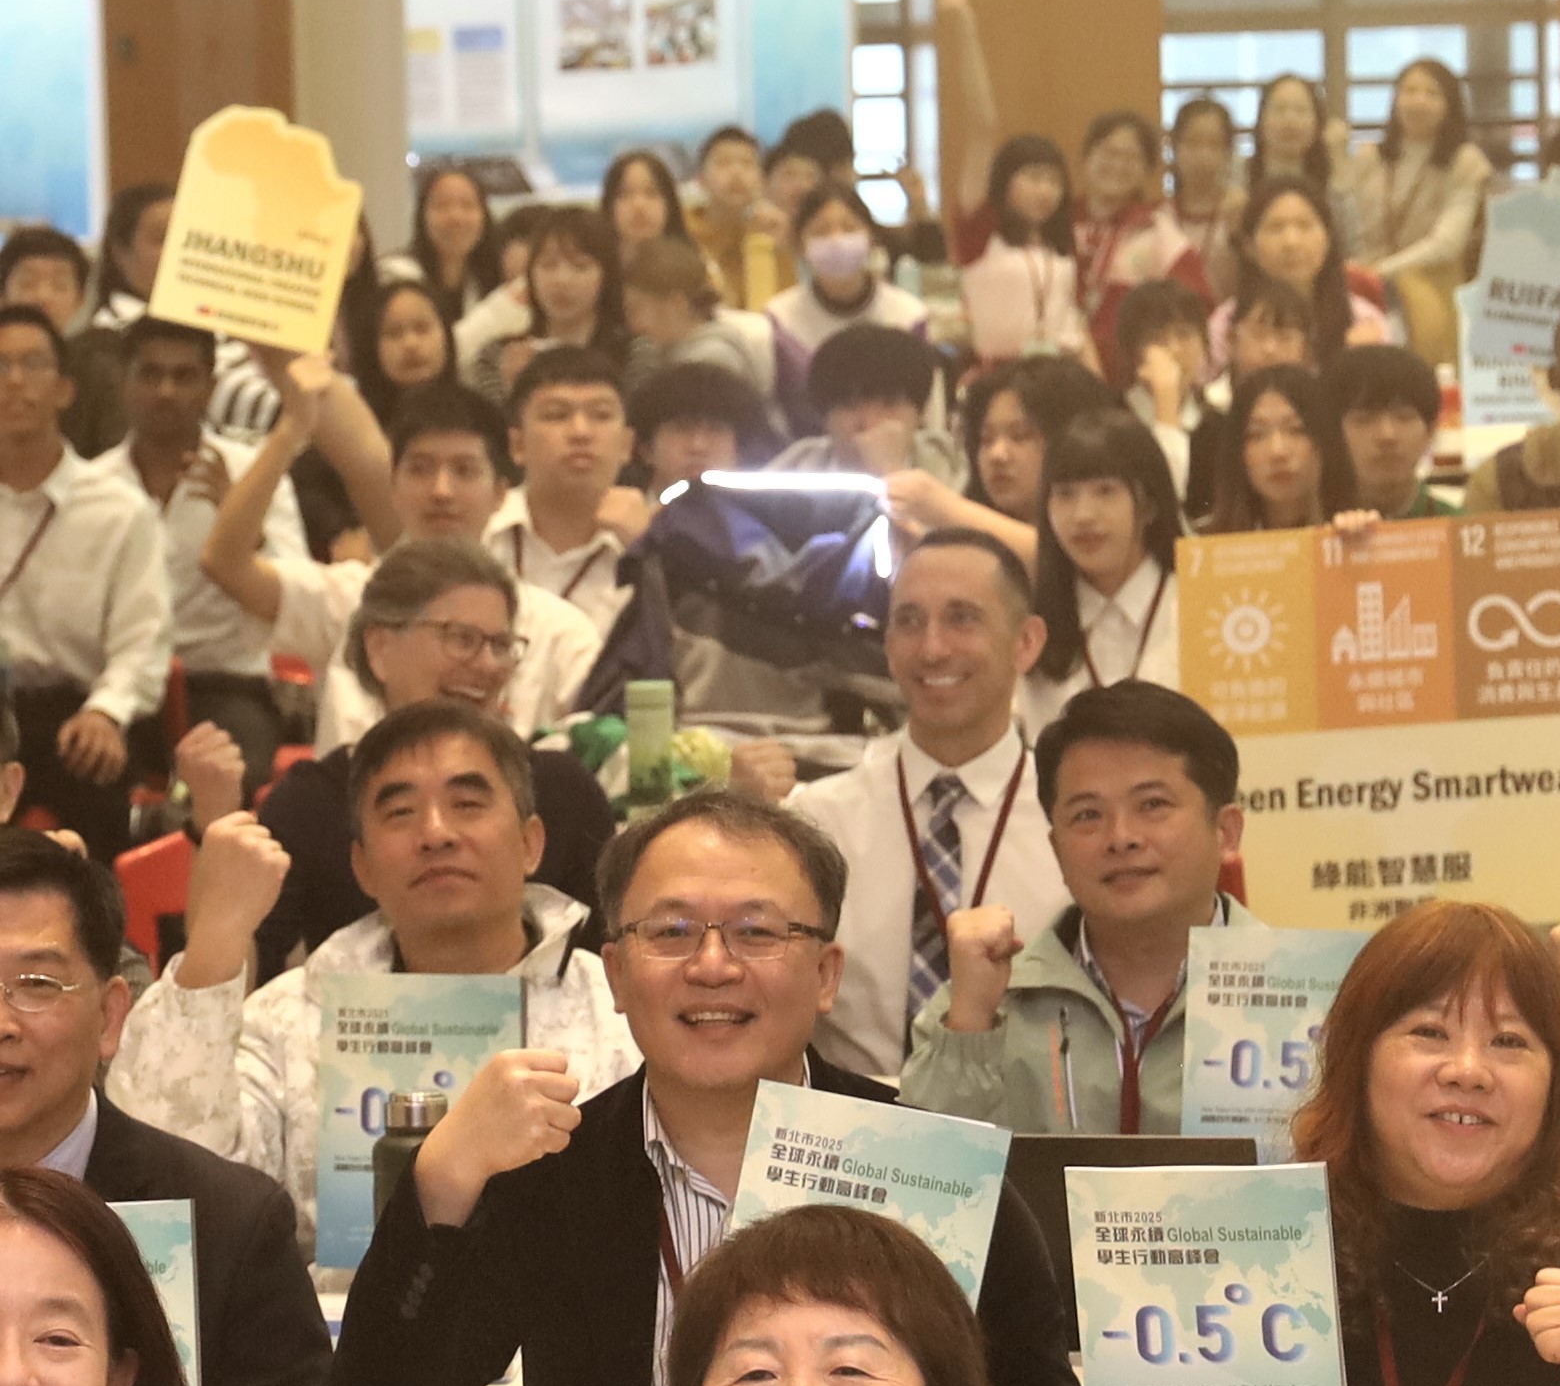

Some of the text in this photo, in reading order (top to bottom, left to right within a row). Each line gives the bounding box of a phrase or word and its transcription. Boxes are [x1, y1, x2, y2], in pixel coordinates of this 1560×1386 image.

[1321, 536, 1343, 569] 11
[1460, 524, 1487, 558] 12
[1297, 777, 1403, 812] Energy
[1312, 851, 1472, 890] 綠能智慧服
[1267, 976, 1306, 991] Global
[392, 1023, 429, 1036] Global
[774, 1127, 844, 1152] 新北市2025
[766, 1165, 888, 1205] 學生行動高峰會
[770, 1142, 974, 1199] 全球永續 Global Sustainable
[1094, 1211, 1163, 1224] 新北市2025
[1095, 1225, 1303, 1244] 全球永續 Global Sustainable
[1096, 1248, 1220, 1266] 學生行動高峰會
[1102, 1284, 1307, 1365] -0.5°C
